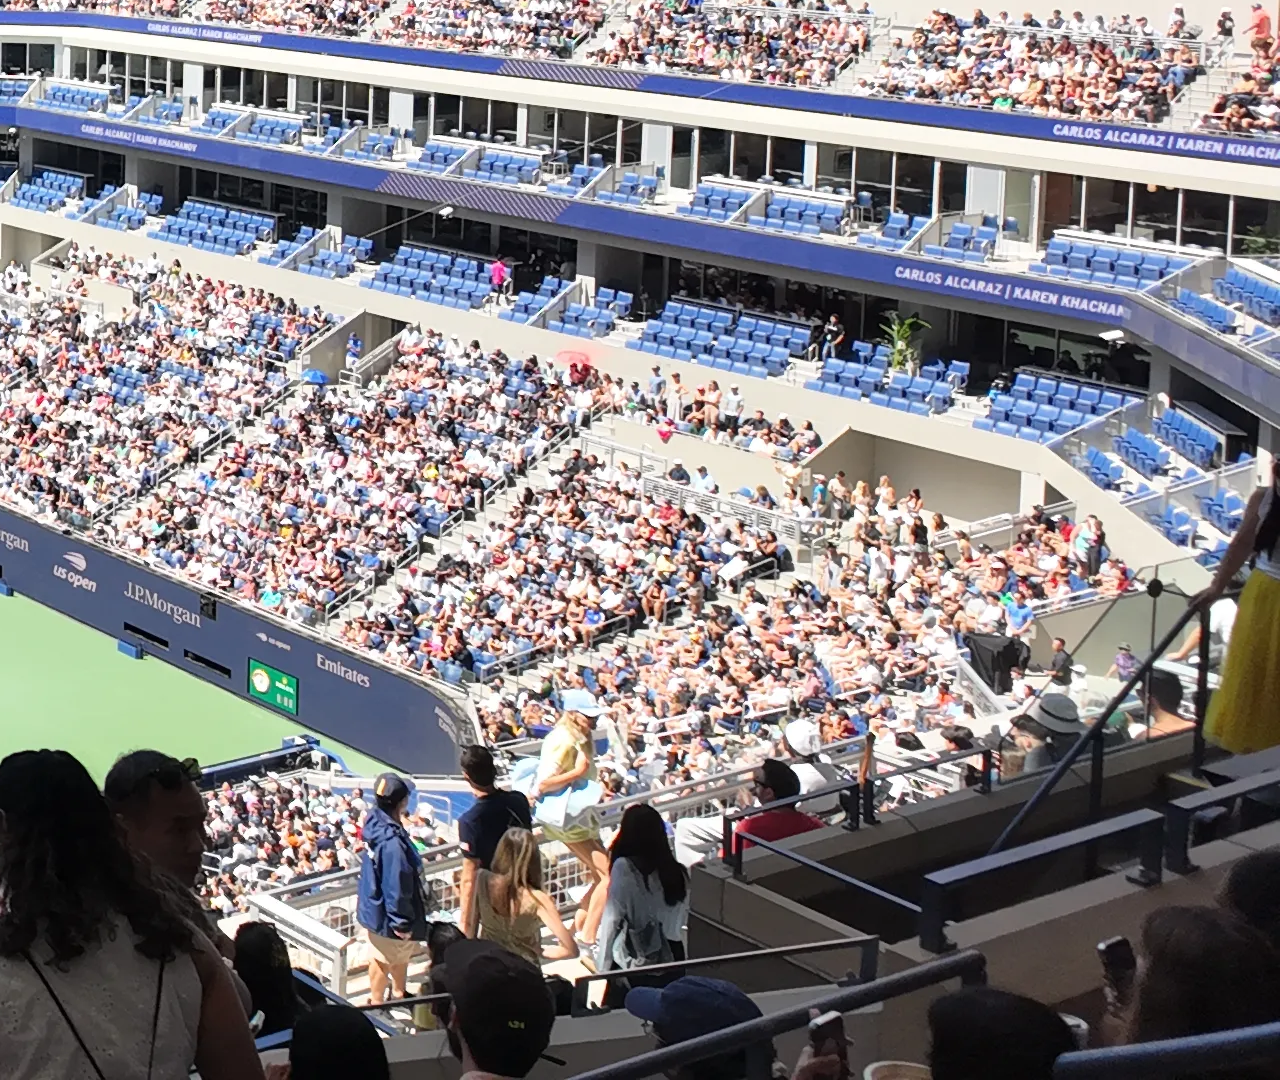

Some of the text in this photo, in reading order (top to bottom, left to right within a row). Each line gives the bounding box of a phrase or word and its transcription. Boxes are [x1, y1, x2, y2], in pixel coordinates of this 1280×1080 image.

[1052, 123, 1102, 141] CARLOS
[1104, 129, 1166, 148] ALCARAZ
[1175, 136, 1224, 154] KAREN
[1225, 142, 1280, 160] KHACHA
[894, 265, 942, 285] CARLOS
[943, 274, 1003, 297] ALCARAZ
[1012, 286, 1059, 305] KAREN
[1060, 294, 1132, 320] KHACHAN
[53, 564, 97, 593] us open
[123, 581, 202, 628] J.P.Morgan
[316, 653, 370, 688] Emirates
